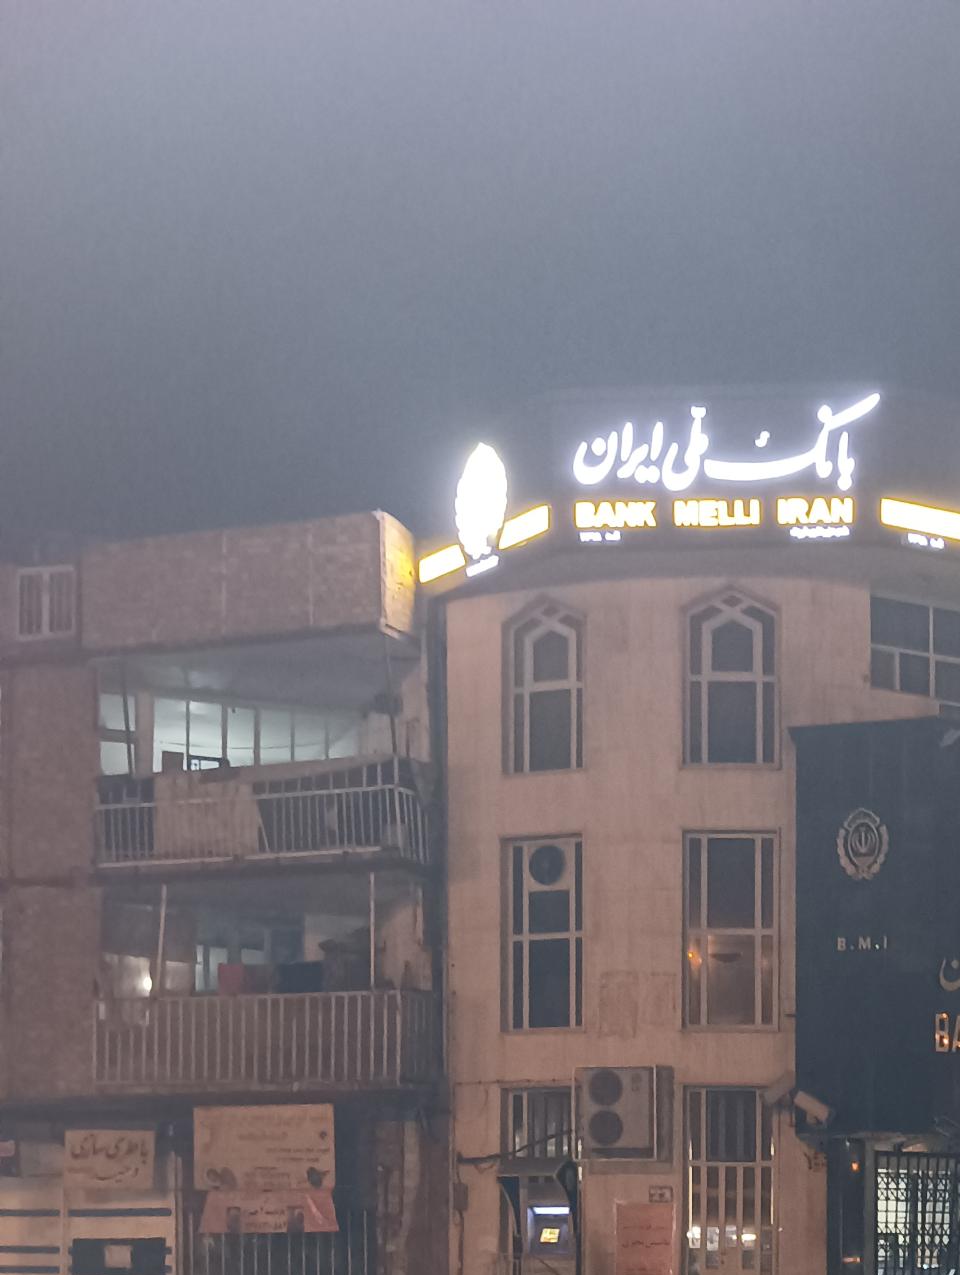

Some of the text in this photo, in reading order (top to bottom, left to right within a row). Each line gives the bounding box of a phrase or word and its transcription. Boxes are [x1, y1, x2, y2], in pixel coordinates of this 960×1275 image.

[572, 420, 664, 486] ایران
[704, 391, 880, 492] بانک
[573, 495, 855, 529] BANK MELLI IRAN
